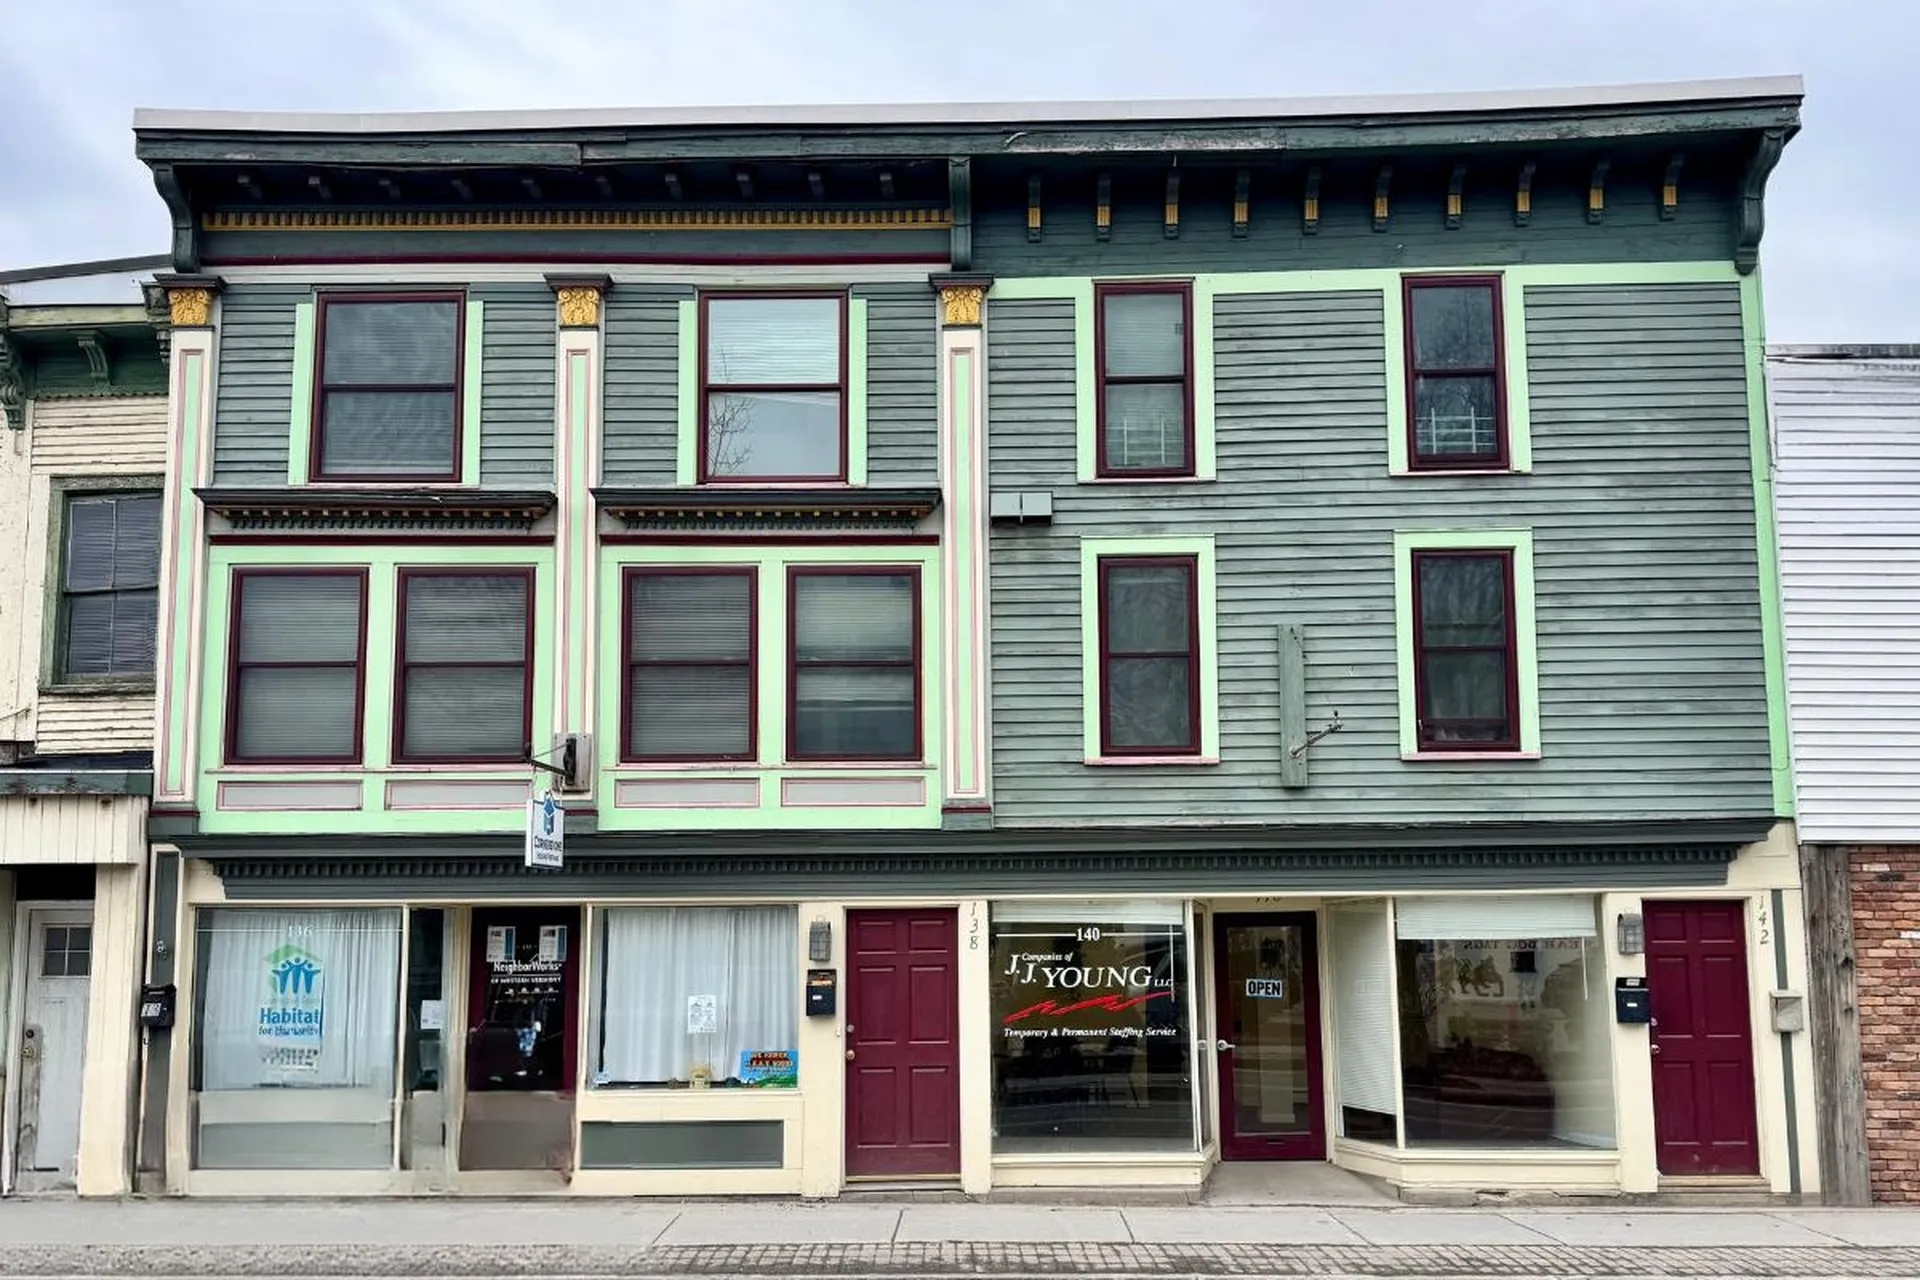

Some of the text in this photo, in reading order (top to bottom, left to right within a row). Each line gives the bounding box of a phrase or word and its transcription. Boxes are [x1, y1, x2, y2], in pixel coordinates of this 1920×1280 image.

[969, 902, 979, 950] 138
[1758, 896, 1770, 945] 142
[1076, 927, 1101, 942] 140
[1021, 951, 1075, 963] Companies of
[1041, 966, 1153, 988] YOUNG
[1247, 980, 1281, 996] OPEN
[259, 1007, 320, 1024] Habitat
[258, 1026, 273, 1035] for
[1004, 1027, 1177, 1040] Temporary & Permanent Staffing Service
